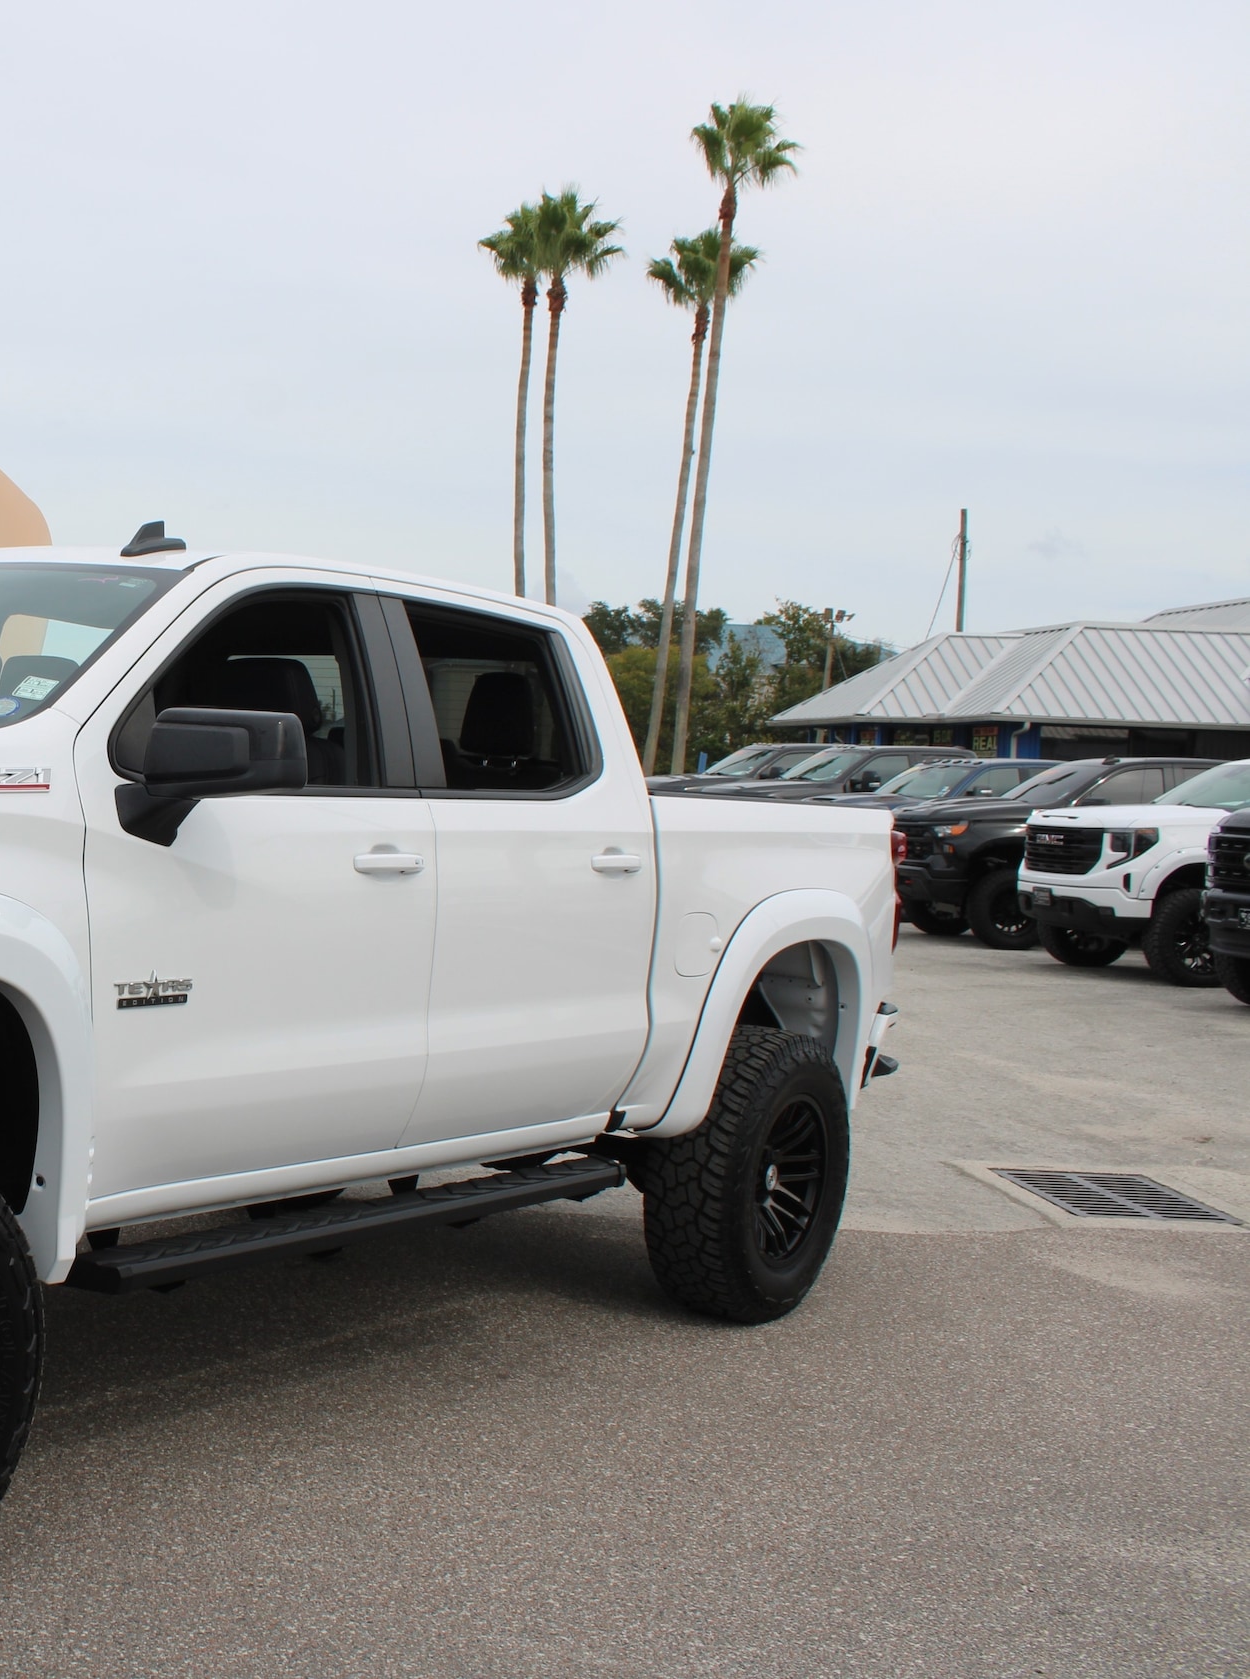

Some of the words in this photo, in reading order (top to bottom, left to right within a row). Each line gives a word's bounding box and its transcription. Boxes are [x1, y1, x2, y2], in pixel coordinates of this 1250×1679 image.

[972, 736, 998, 750] REAL
[1036, 833, 1064, 845] GMC
[113, 970, 192, 998] TEXAS
[122, 996, 184, 1007] EDITION
